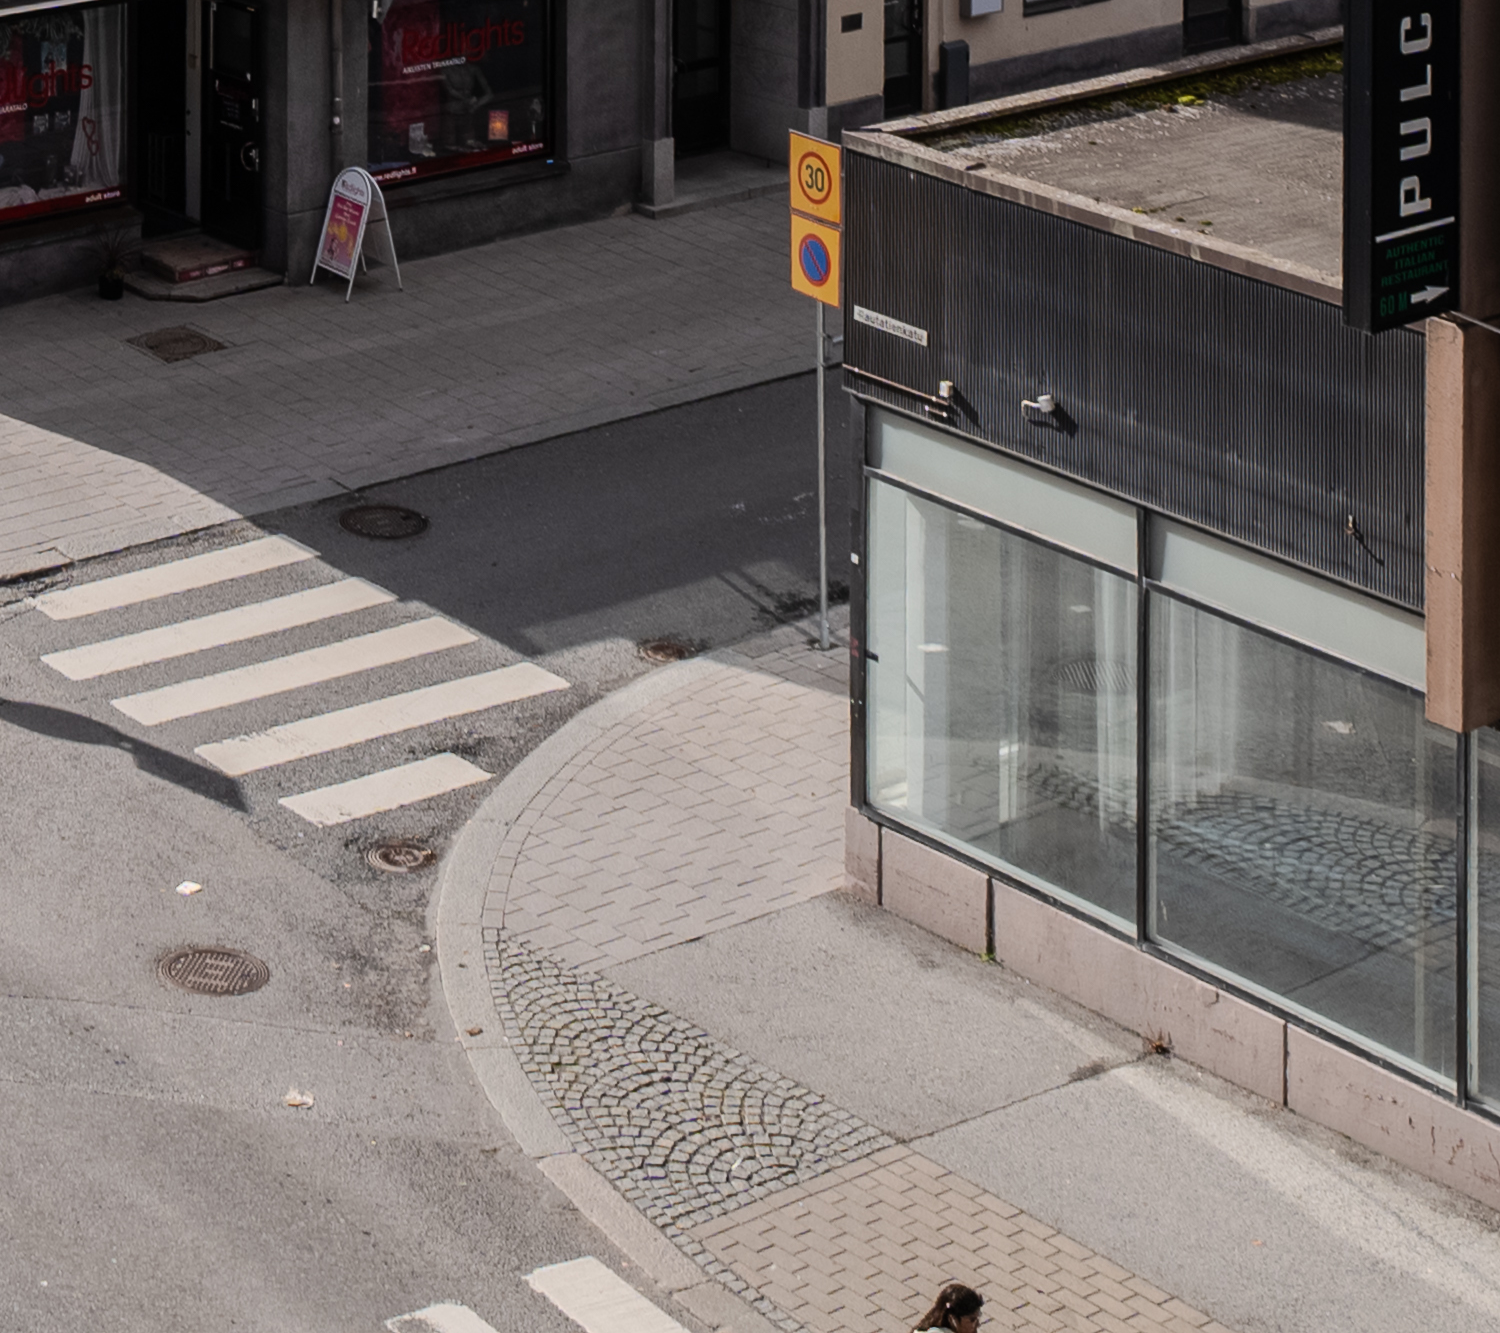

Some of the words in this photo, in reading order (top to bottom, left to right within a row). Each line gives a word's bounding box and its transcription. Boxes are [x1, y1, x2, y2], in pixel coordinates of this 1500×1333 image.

[402, 17, 525, 63] Redlights
[511, 144, 527, 155] adult
[805, 164, 825, 193] 30
[85, 193, 102, 204] adult
[103, 190, 121, 200] store
[1386, 235, 1444, 260] AUTHENTIC
[1381, 259, 1448, 287] RESTAURANT
[1395, 251, 1435, 270] ITALIAN
[1381, 295, 1395, 317] 60
[1399, 291, 1408, 312] M
